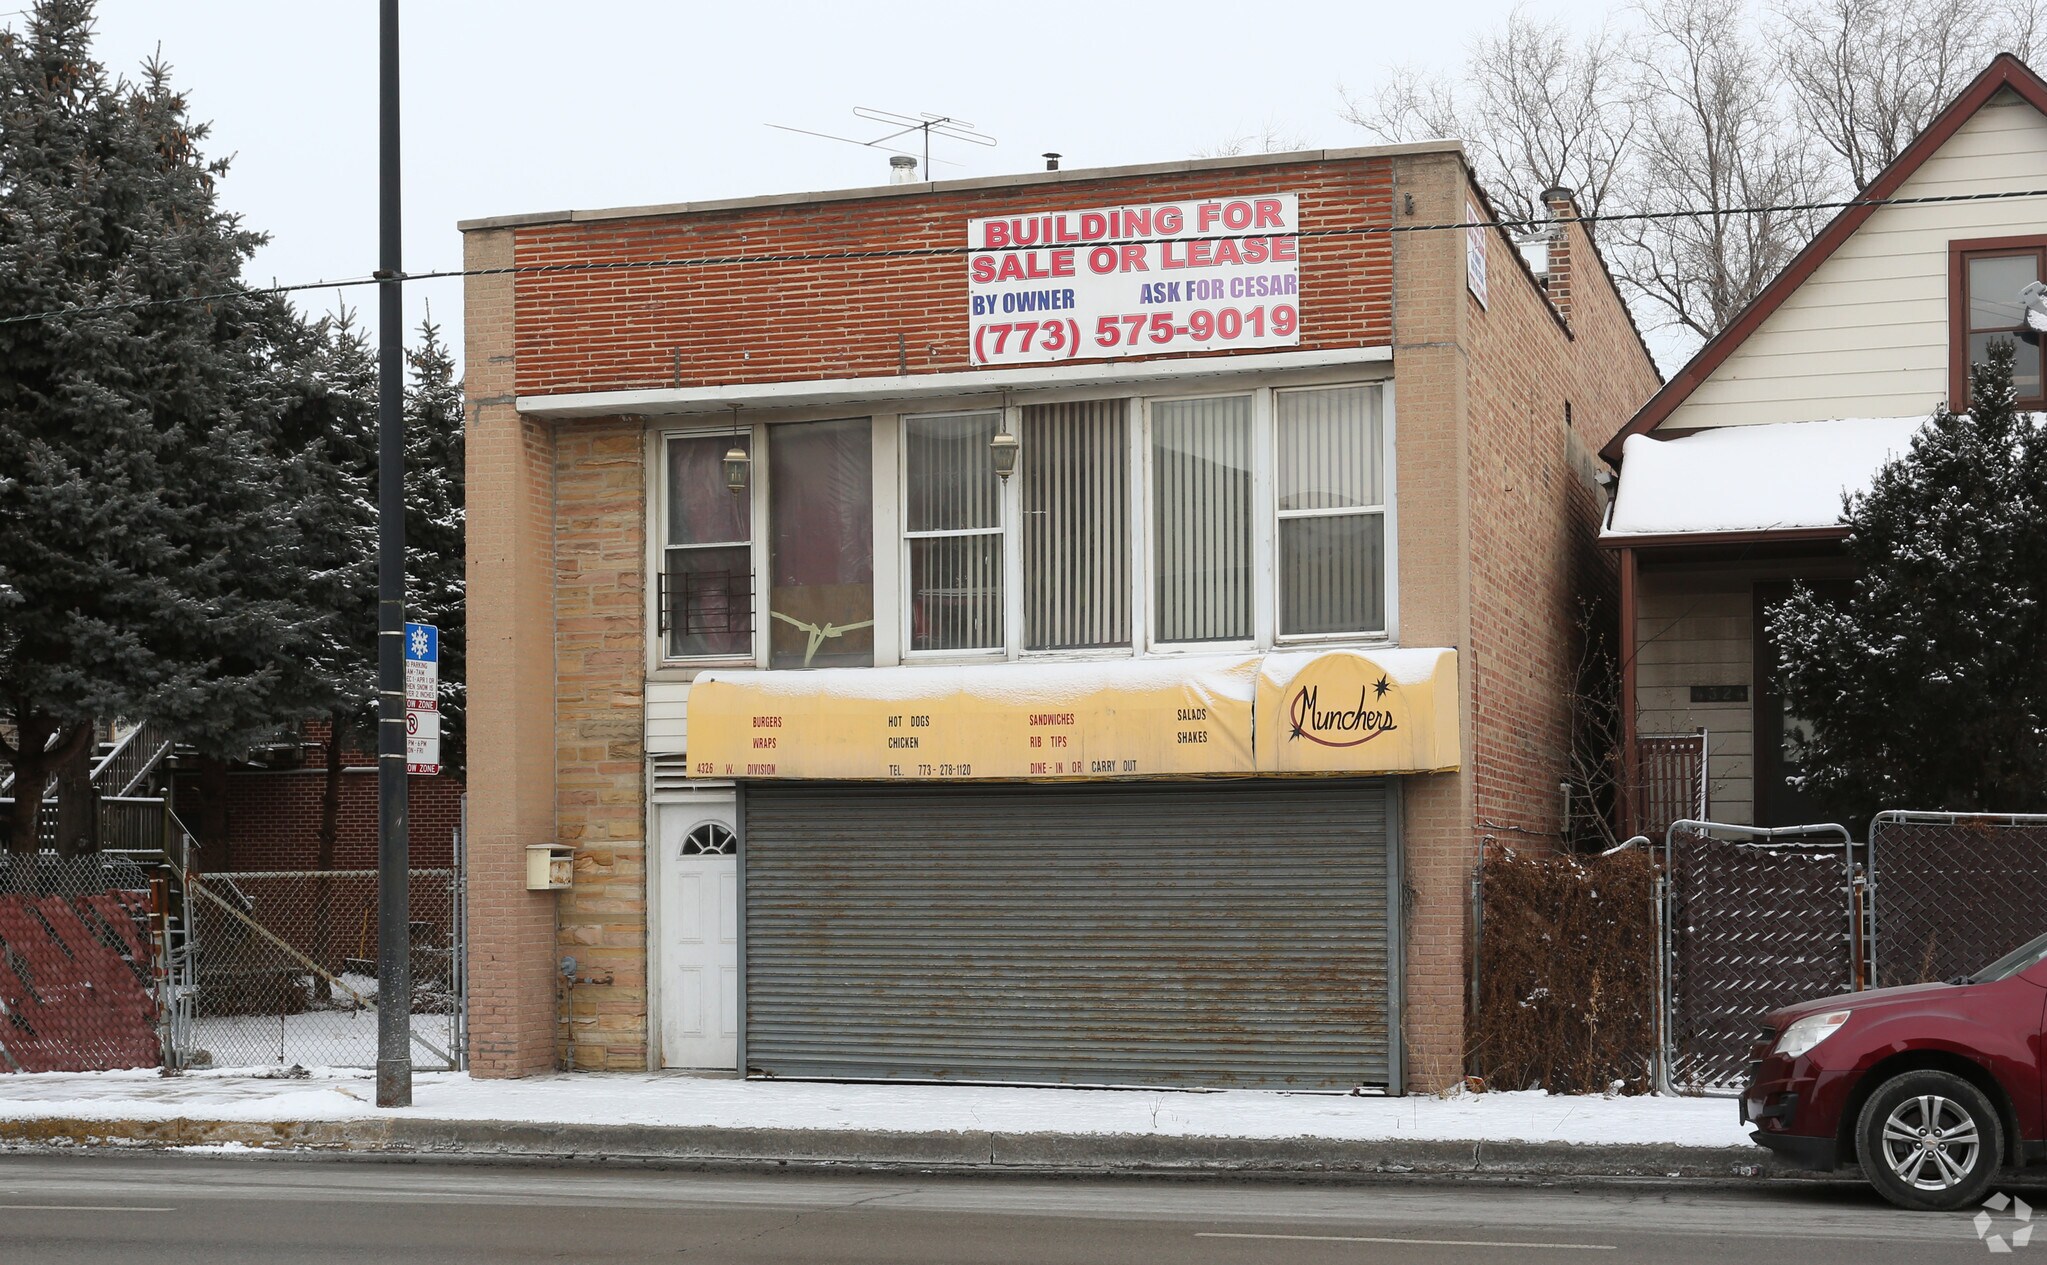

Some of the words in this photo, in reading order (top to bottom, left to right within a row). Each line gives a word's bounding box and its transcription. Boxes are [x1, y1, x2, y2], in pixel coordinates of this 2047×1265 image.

[984, 206, 1183, 248] BUILDING
[1197, 199, 1285, 233] FOR
[971, 249, 1075, 283] SALE
[1087, 243, 1150, 275] OR
[1160, 235, 1297, 270] LEASE
[1140, 281, 1181, 304] ASK
[1186, 278, 1226, 301] FOR
[1230, 274, 1297, 299] CESAR
[972, 295, 997, 315] BY
[1003, 288, 1075, 313] OWNER
[973, 318, 1080, 363] (773)
[1094, 304, 1297, 347] 575-9019
[407, 700, 416, 708] OW
[418, 701, 434, 709] ZONE
[1299, 685, 1398, 731] Munchers
[888, 716, 902, 727] HOT
[910, 715, 930, 727] DOGS
[1029, 713, 1075, 726] SANDWICHES
[1177, 708, 1207, 721] SALADS
[753, 716, 782, 728] BURGERS
[753, 738, 776, 749] WRAPS
[888, 737, 919, 749] CHICKEN
[1030, 737, 1042, 748] RIB
[1051, 736, 1067, 748] TIPS
[1177, 731, 1208, 744] SHAKES
[407, 764, 416, 772] OW
[420, 764, 435, 773] ZONE
[697, 763, 713, 774] 4326
[747, 764, 776, 775] DIVISION
[889, 764, 904, 776] TEL.
[1072, 761, 1082, 773] OR
[1091, 760, 1116, 772] CARRY
[1123, 760, 1137, 772] OUT
